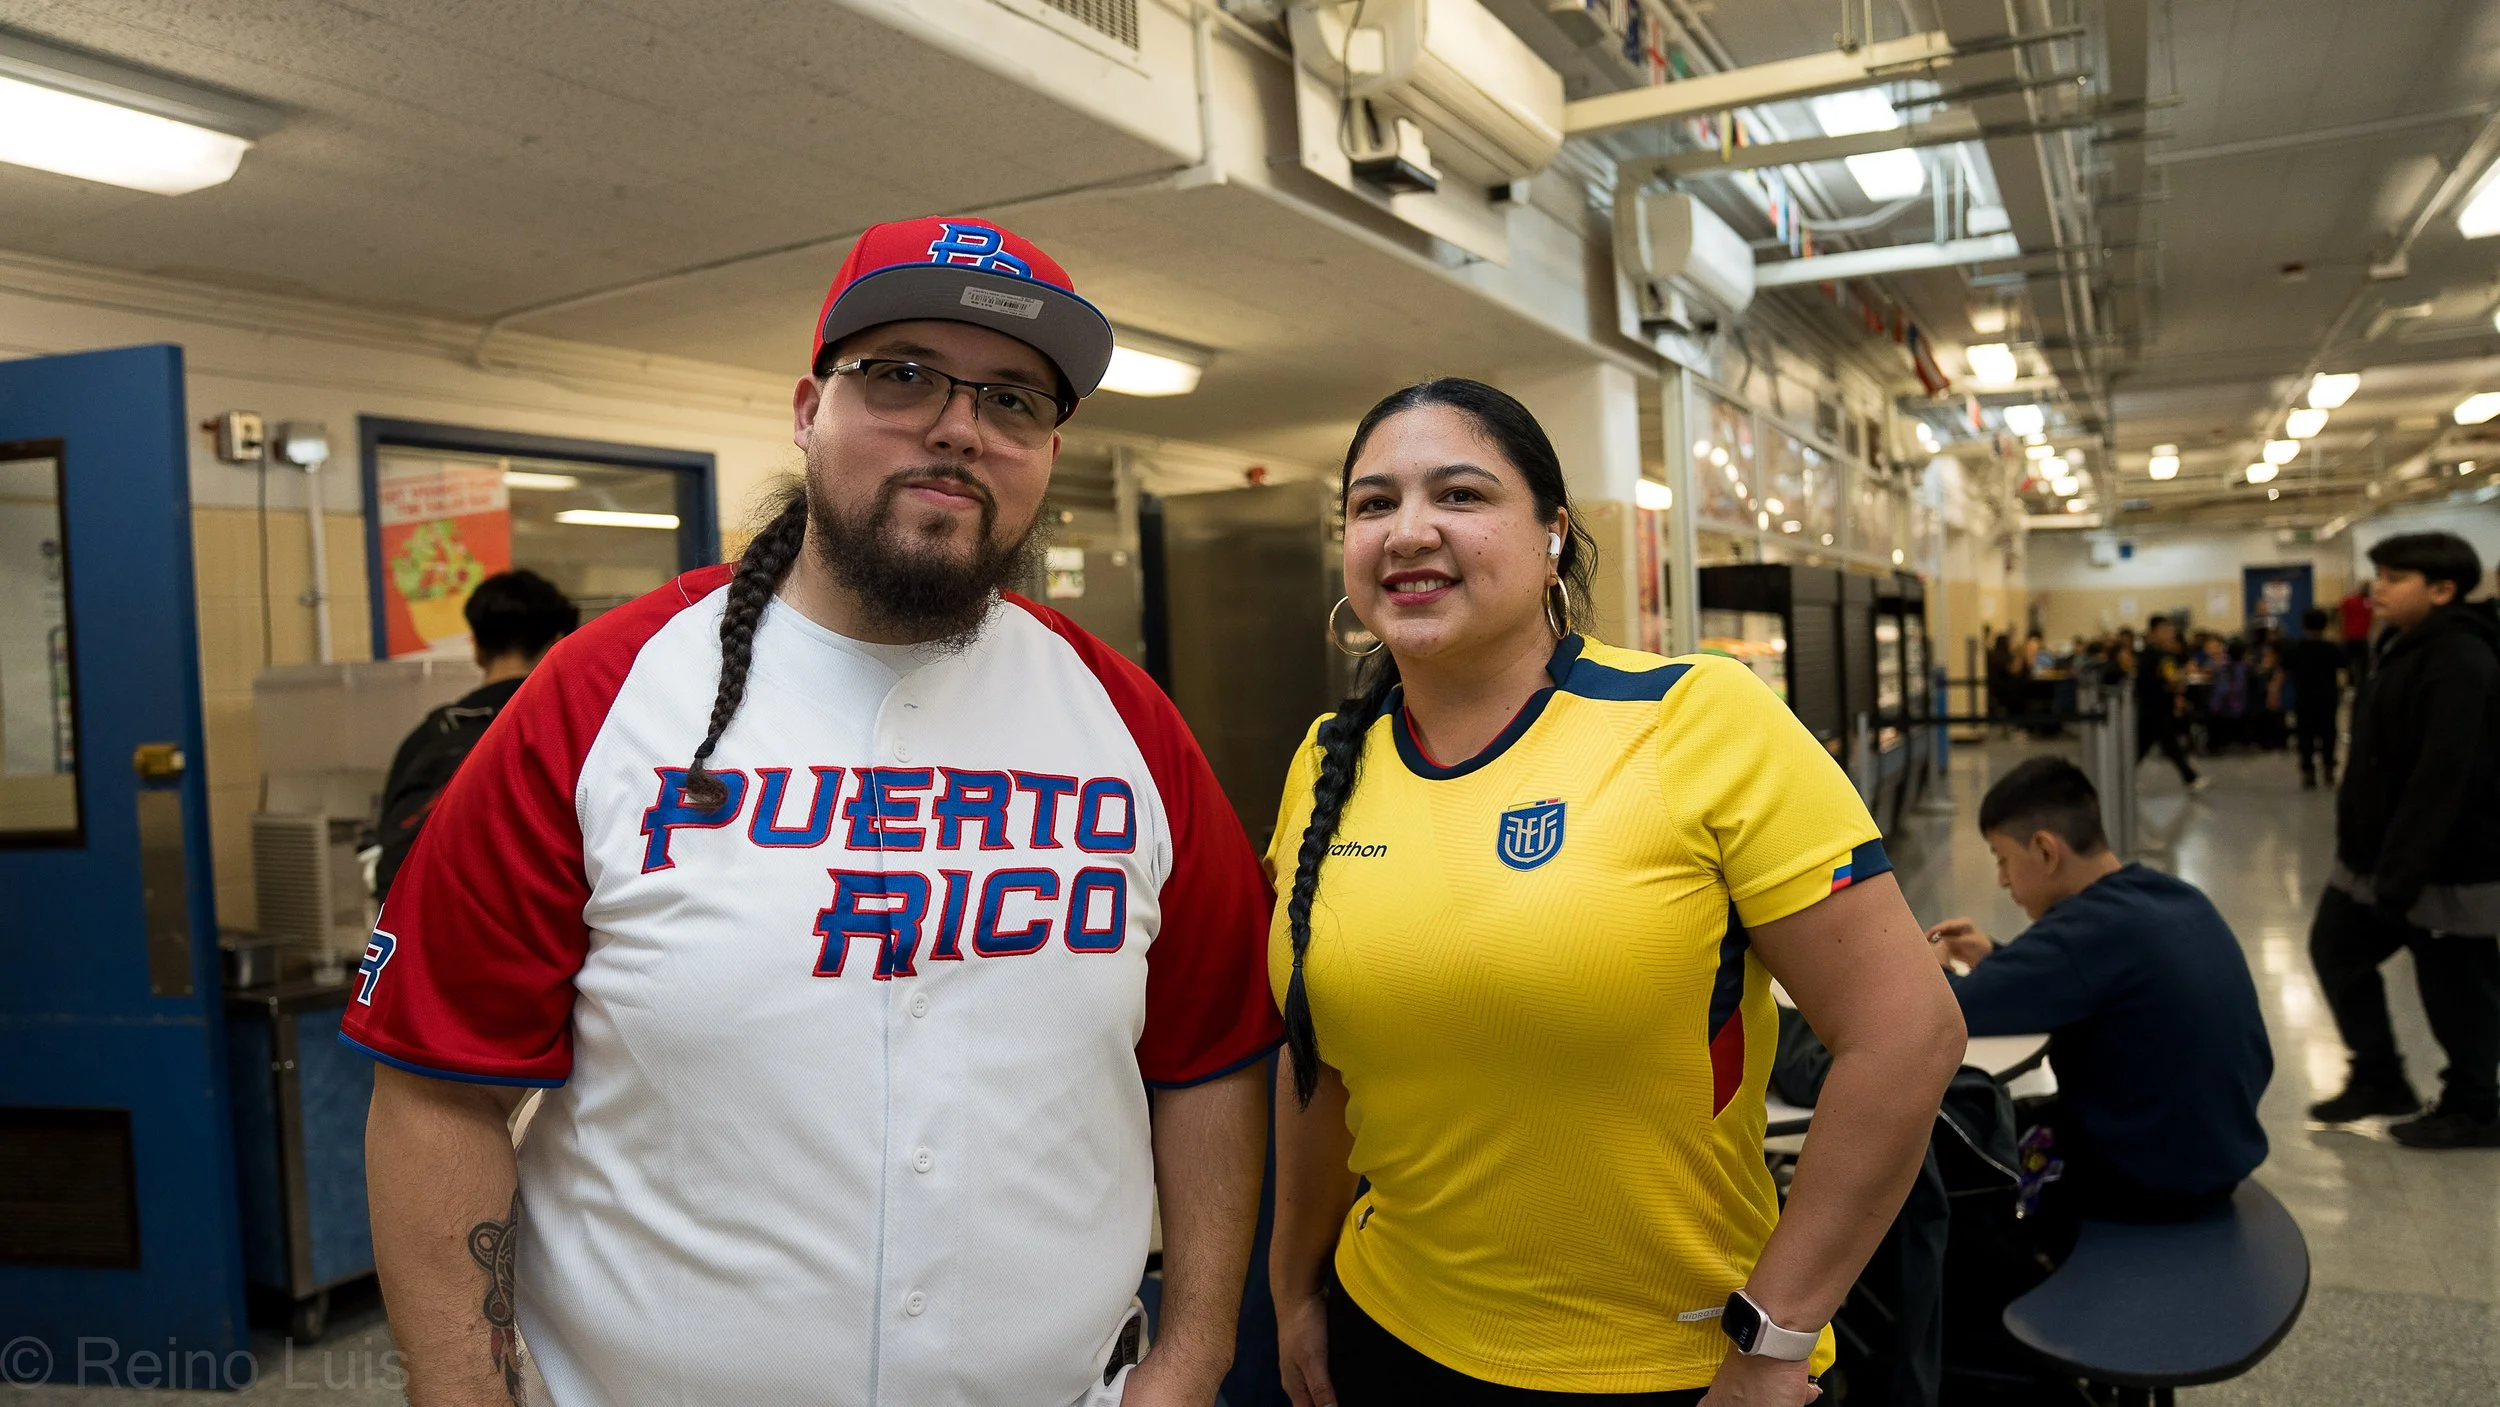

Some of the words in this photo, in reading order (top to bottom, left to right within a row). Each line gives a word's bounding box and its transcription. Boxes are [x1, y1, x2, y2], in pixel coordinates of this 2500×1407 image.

[641, 766, 1137, 874] PUERTO
[1326, 841, 1387, 857] rathon
[812, 866, 1129, 980] RICO
